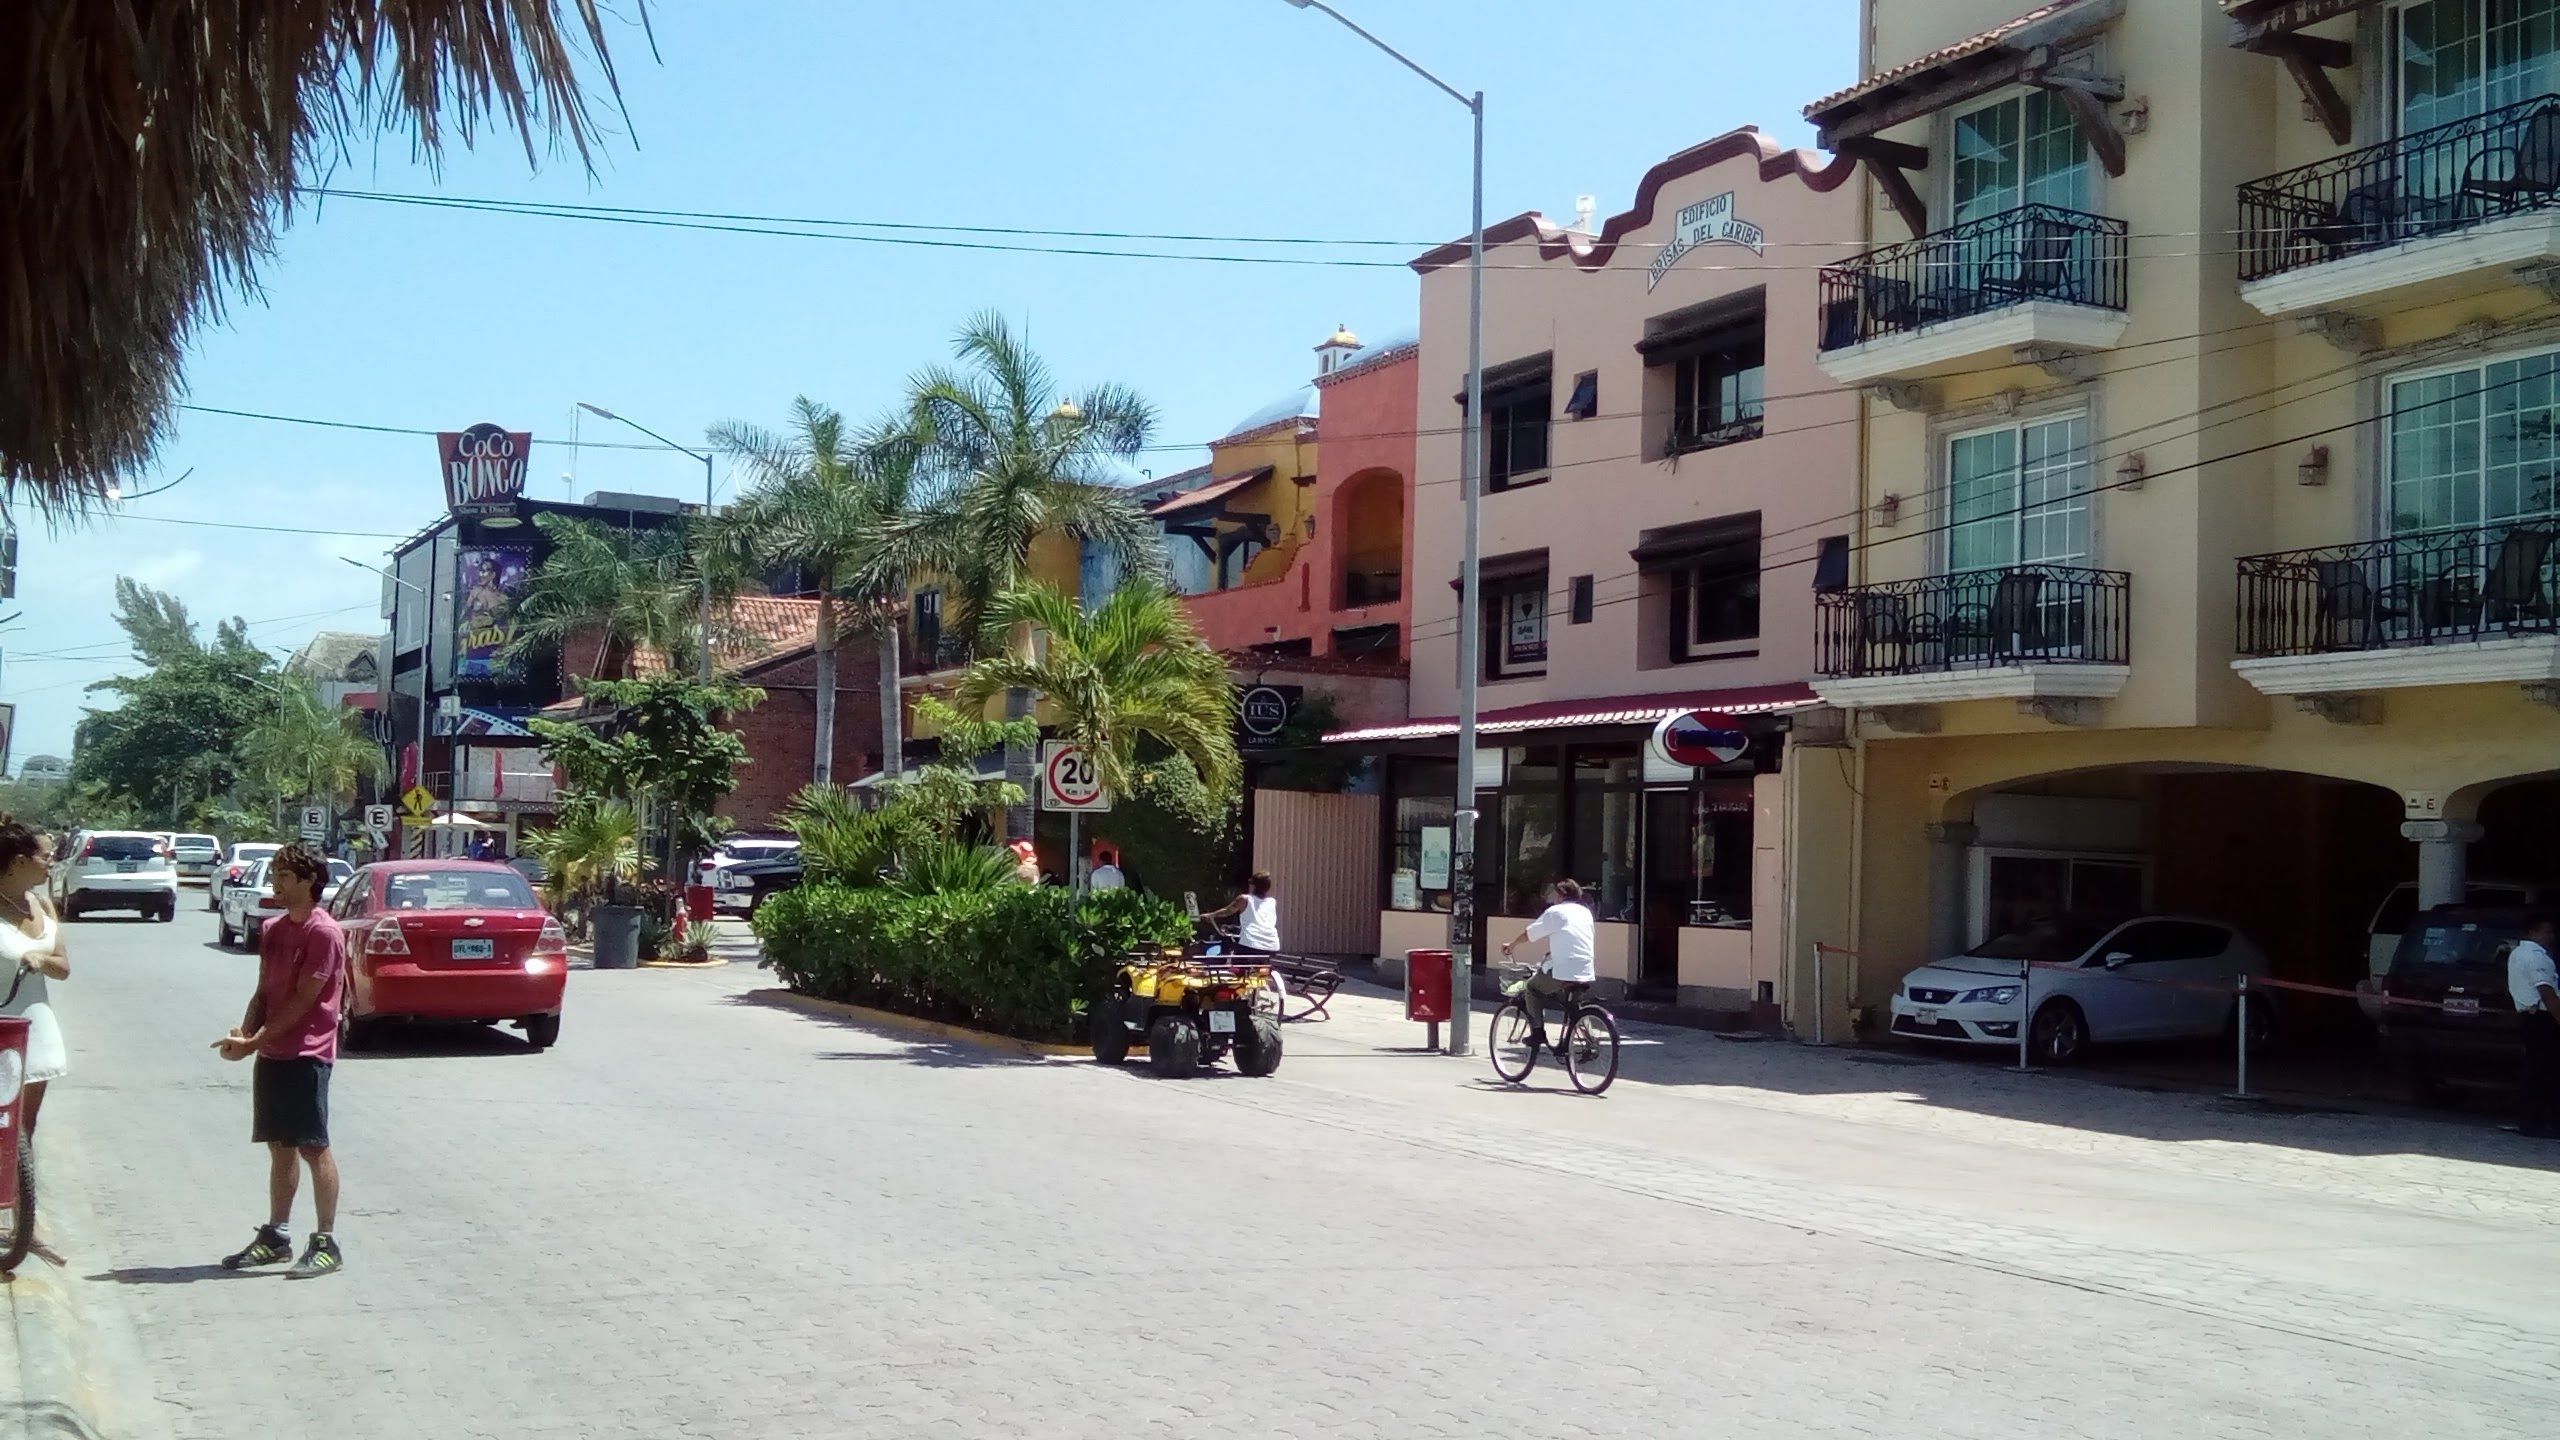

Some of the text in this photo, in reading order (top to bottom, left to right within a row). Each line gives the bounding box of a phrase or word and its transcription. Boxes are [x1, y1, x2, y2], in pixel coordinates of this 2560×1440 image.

[1682, 196, 1727, 227] EDIFICIO
[1650, 220, 1761, 281] BRISAS DEL CARIBE
[449, 456, 524, 507] BONGO
[1061, 758, 1095, 785] 20
[308, 812, 319, 824] E
[373, 811, 384, 825] E
